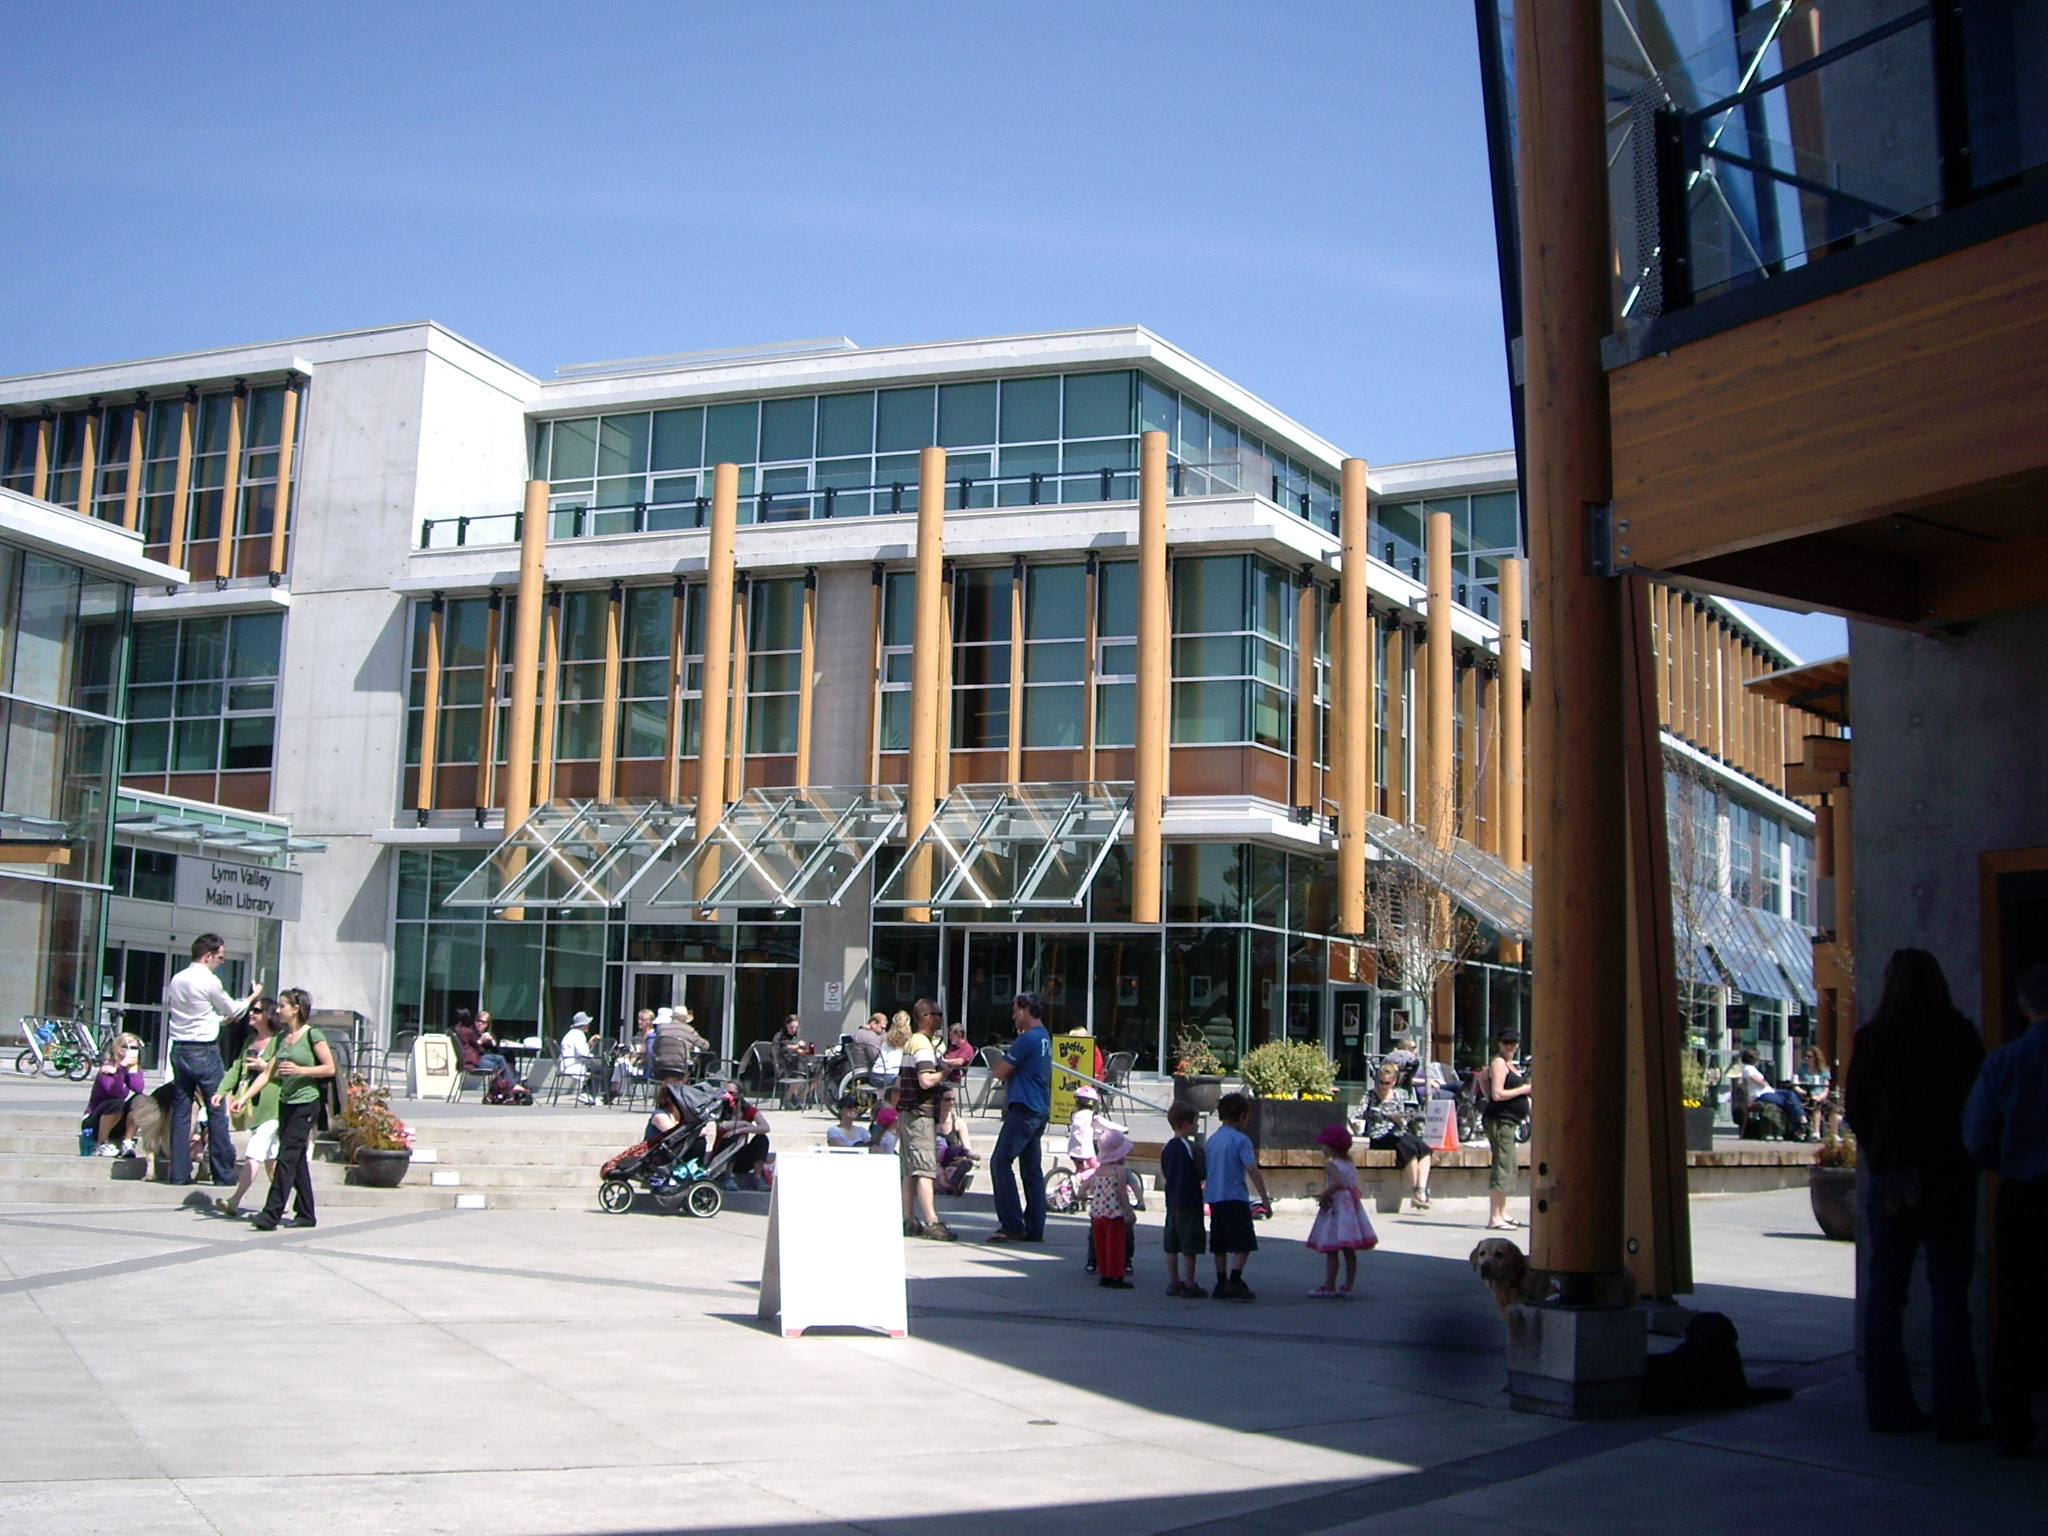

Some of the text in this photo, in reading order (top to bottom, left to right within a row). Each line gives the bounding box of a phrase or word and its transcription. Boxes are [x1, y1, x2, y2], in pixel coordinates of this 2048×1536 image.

[211, 863, 272, 891] Lynn Valley
[205, 887, 274, 916] Main Library
